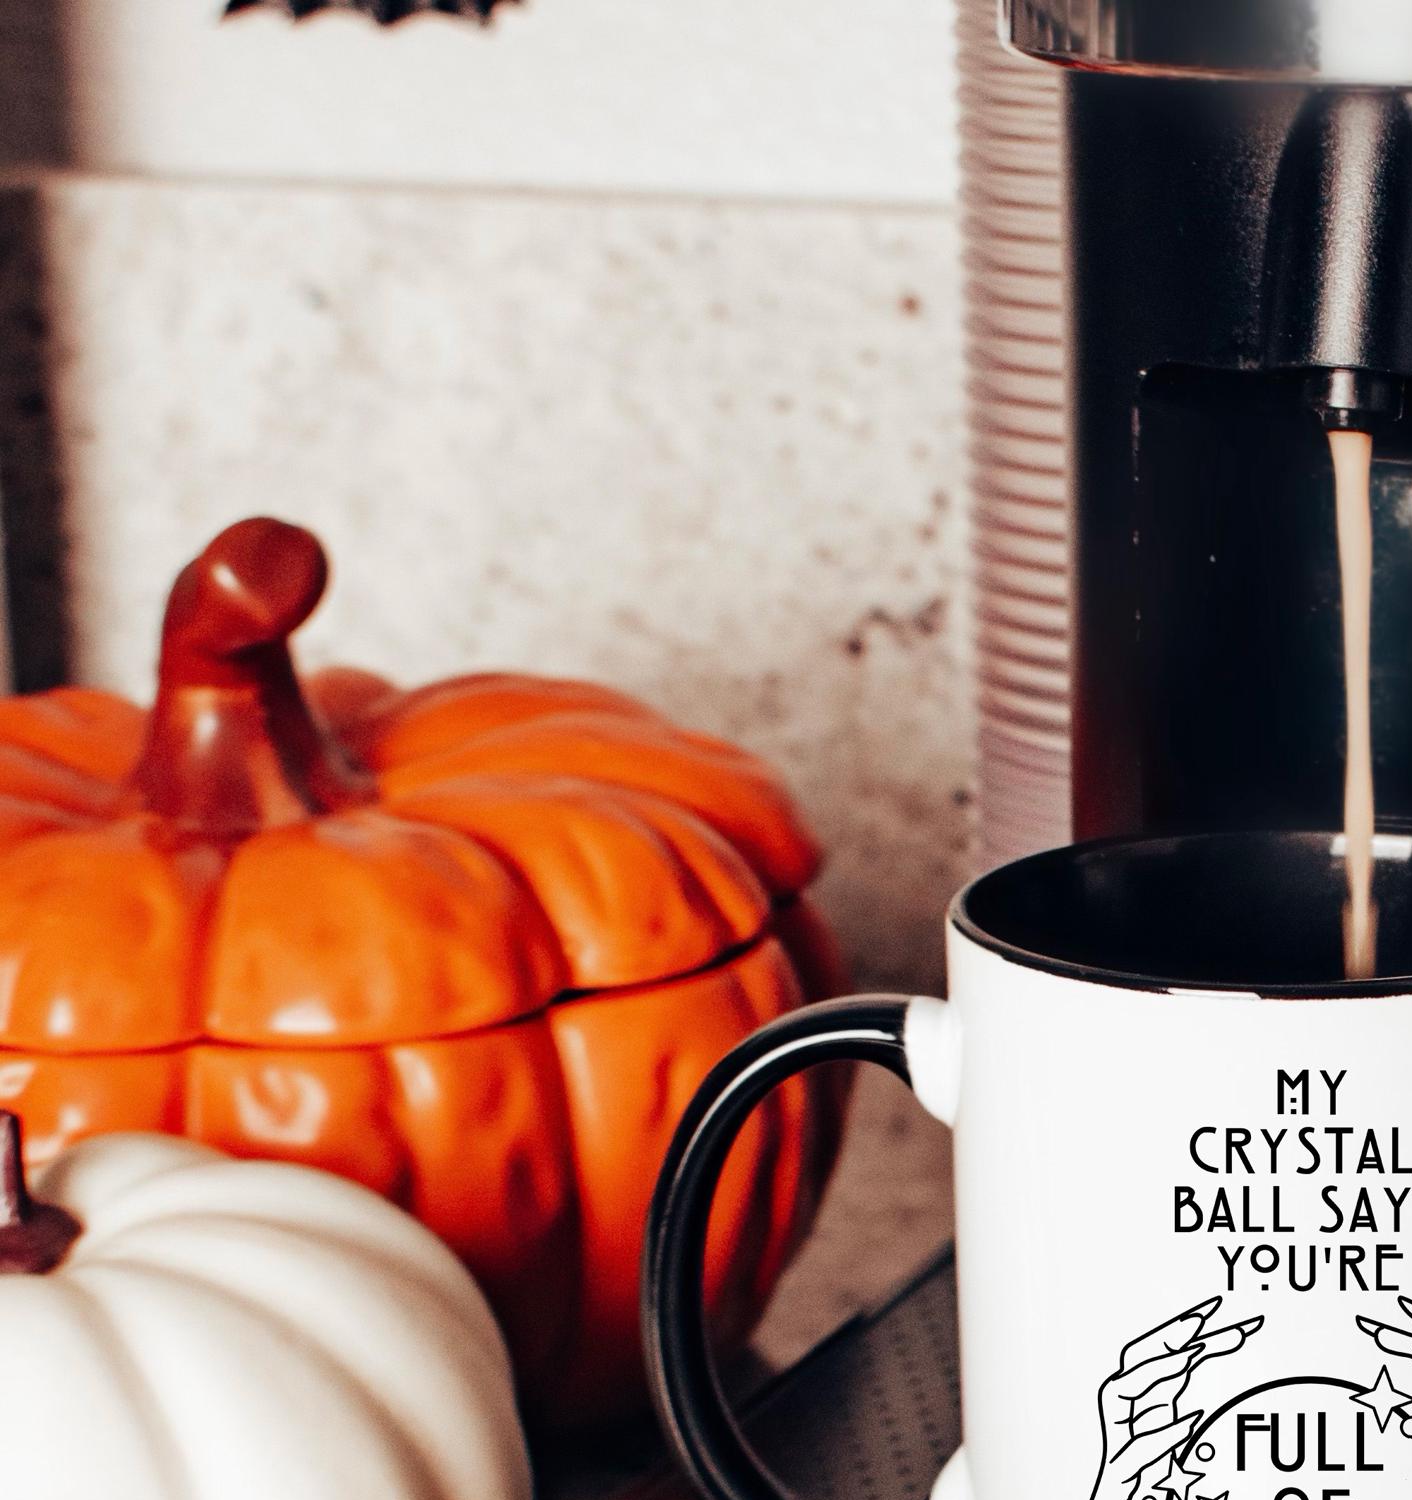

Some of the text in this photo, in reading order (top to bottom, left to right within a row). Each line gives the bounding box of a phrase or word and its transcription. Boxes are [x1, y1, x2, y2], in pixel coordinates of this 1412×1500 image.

[1278, 1070, 1346, 1115] MY
[1190, 1127, 1412, 1174] CRYSTAL
[1175, 1186, 1294, 1232] BALL
[1218, 1245, 1403, 1291] YOU'RE
[1236, 1411, 1384, 1471] FULL
